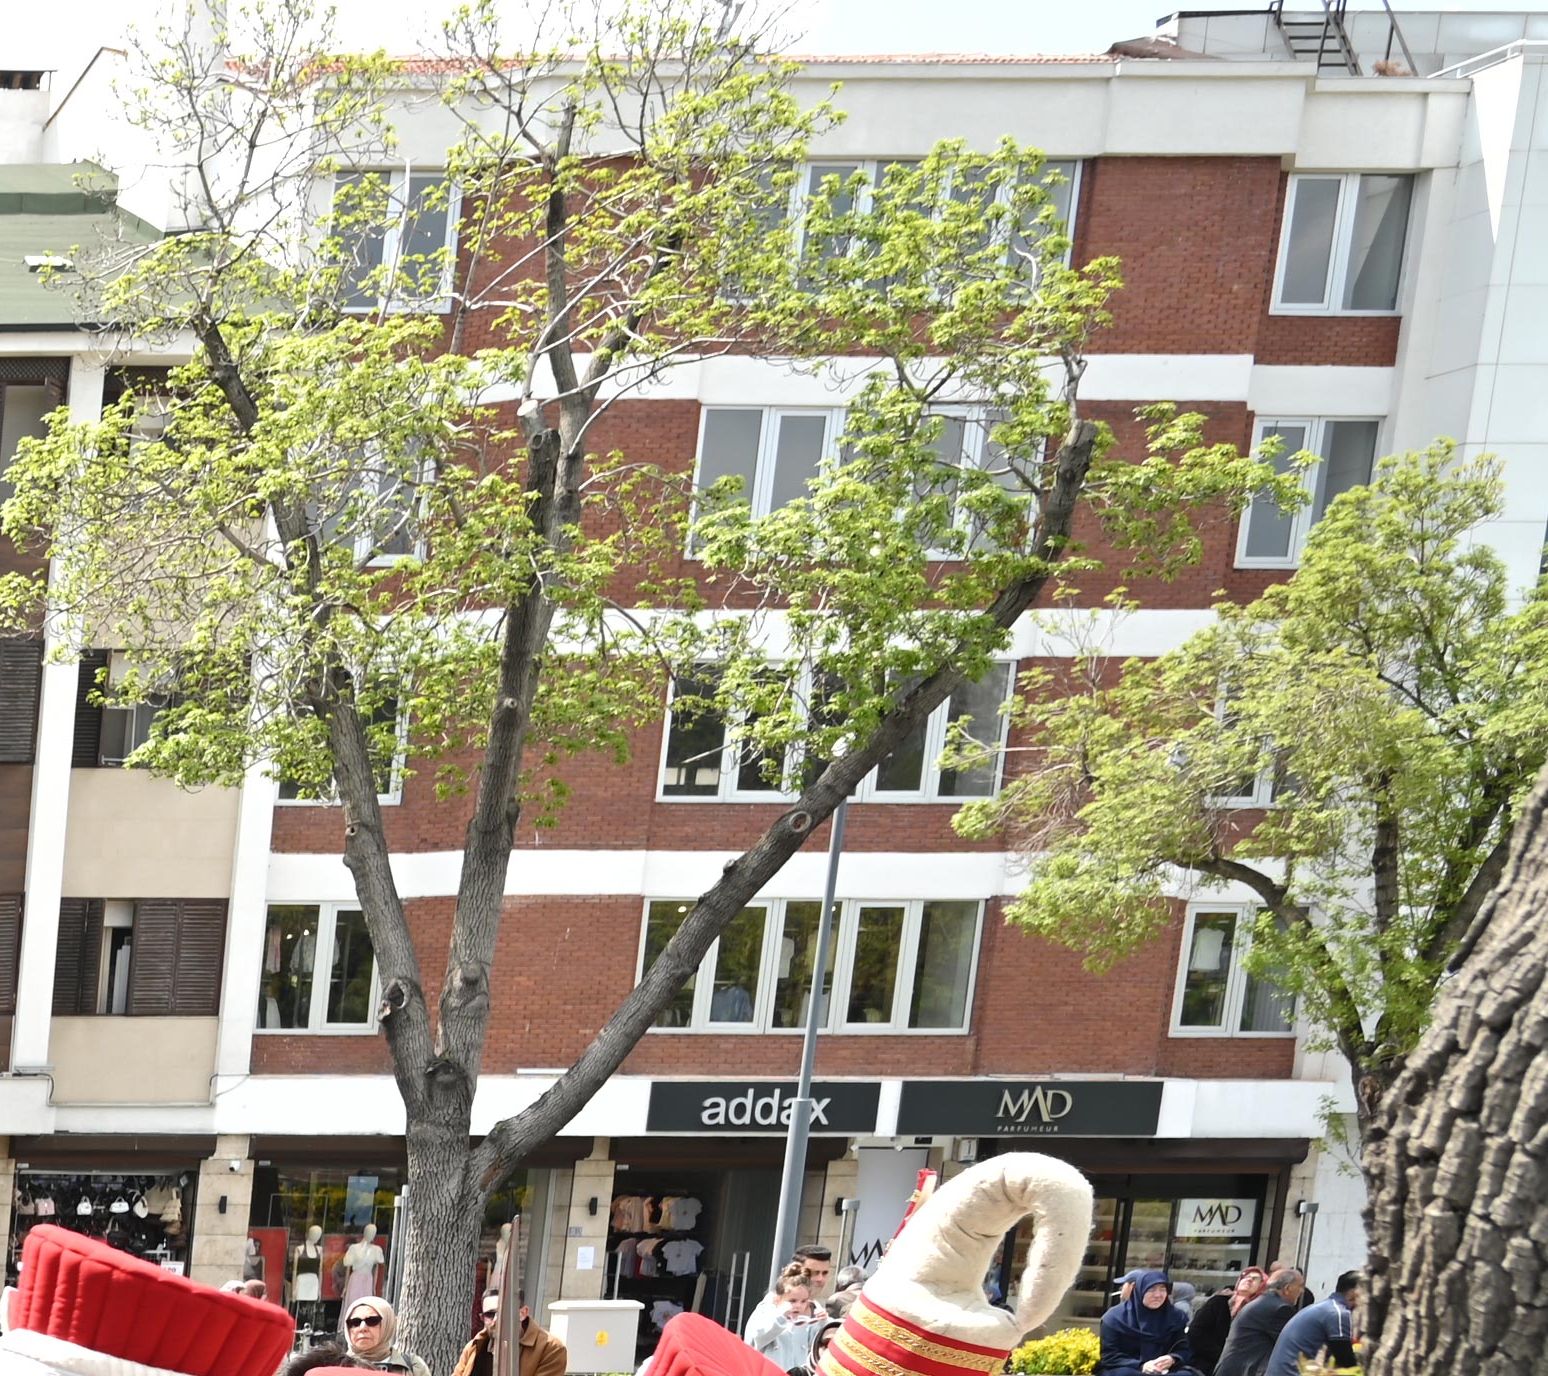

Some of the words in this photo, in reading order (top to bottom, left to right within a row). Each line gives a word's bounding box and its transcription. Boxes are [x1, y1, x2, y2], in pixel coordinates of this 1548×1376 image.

[995, 1085, 1073, 1123] MAD
[996, 1125, 1059, 1133] PARFUMEUR
[1192, 1202, 1243, 1227] MAD
